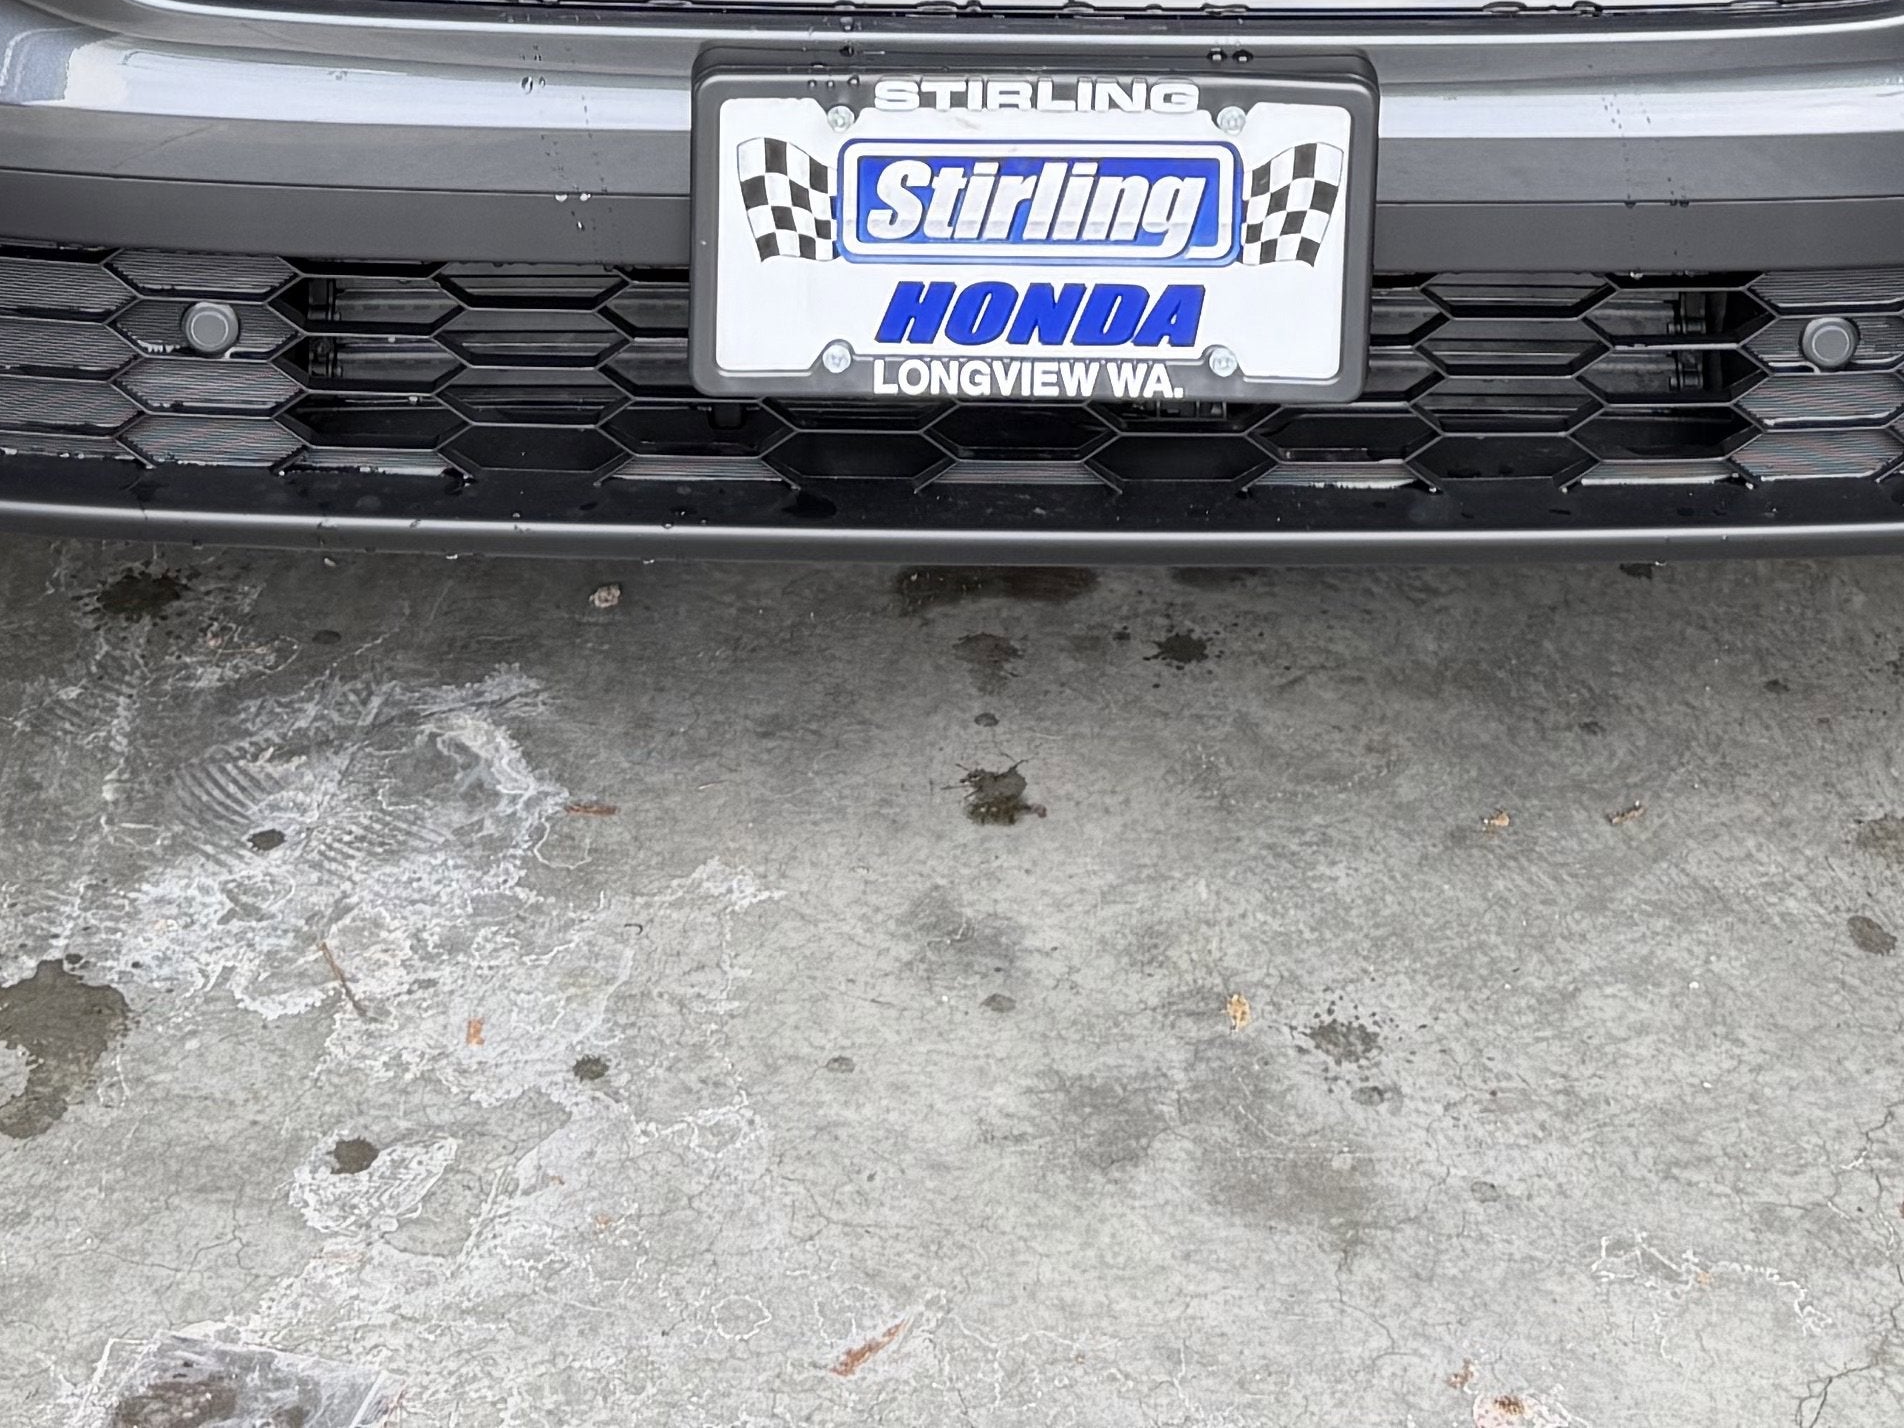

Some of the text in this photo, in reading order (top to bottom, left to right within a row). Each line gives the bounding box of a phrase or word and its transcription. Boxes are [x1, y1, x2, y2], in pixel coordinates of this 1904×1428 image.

[874, 78, 1199, 112] STIRLING
[866, 159, 1206, 258] Stirling
[874, 281, 1205, 347] HONDA
[873, 358, 1184, 398] LONGVIEW WA.
